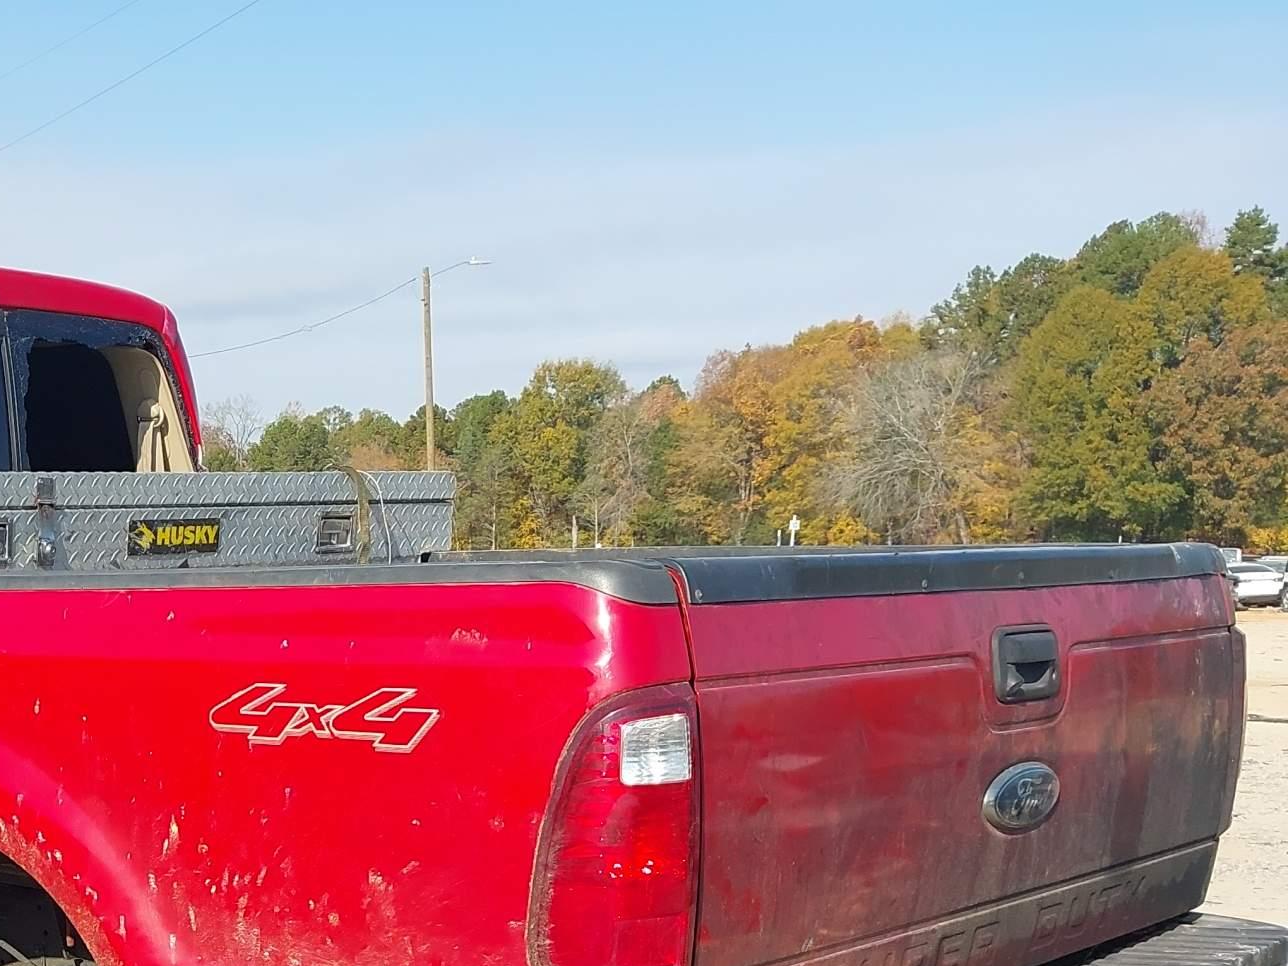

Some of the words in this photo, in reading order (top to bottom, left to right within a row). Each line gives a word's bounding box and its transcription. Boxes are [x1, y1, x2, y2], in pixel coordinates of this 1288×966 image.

[156, 525, 218, 545] HUSKY
[209, 683, 440, 754] 4x4
[1030, 874, 1150, 954] DUTY
